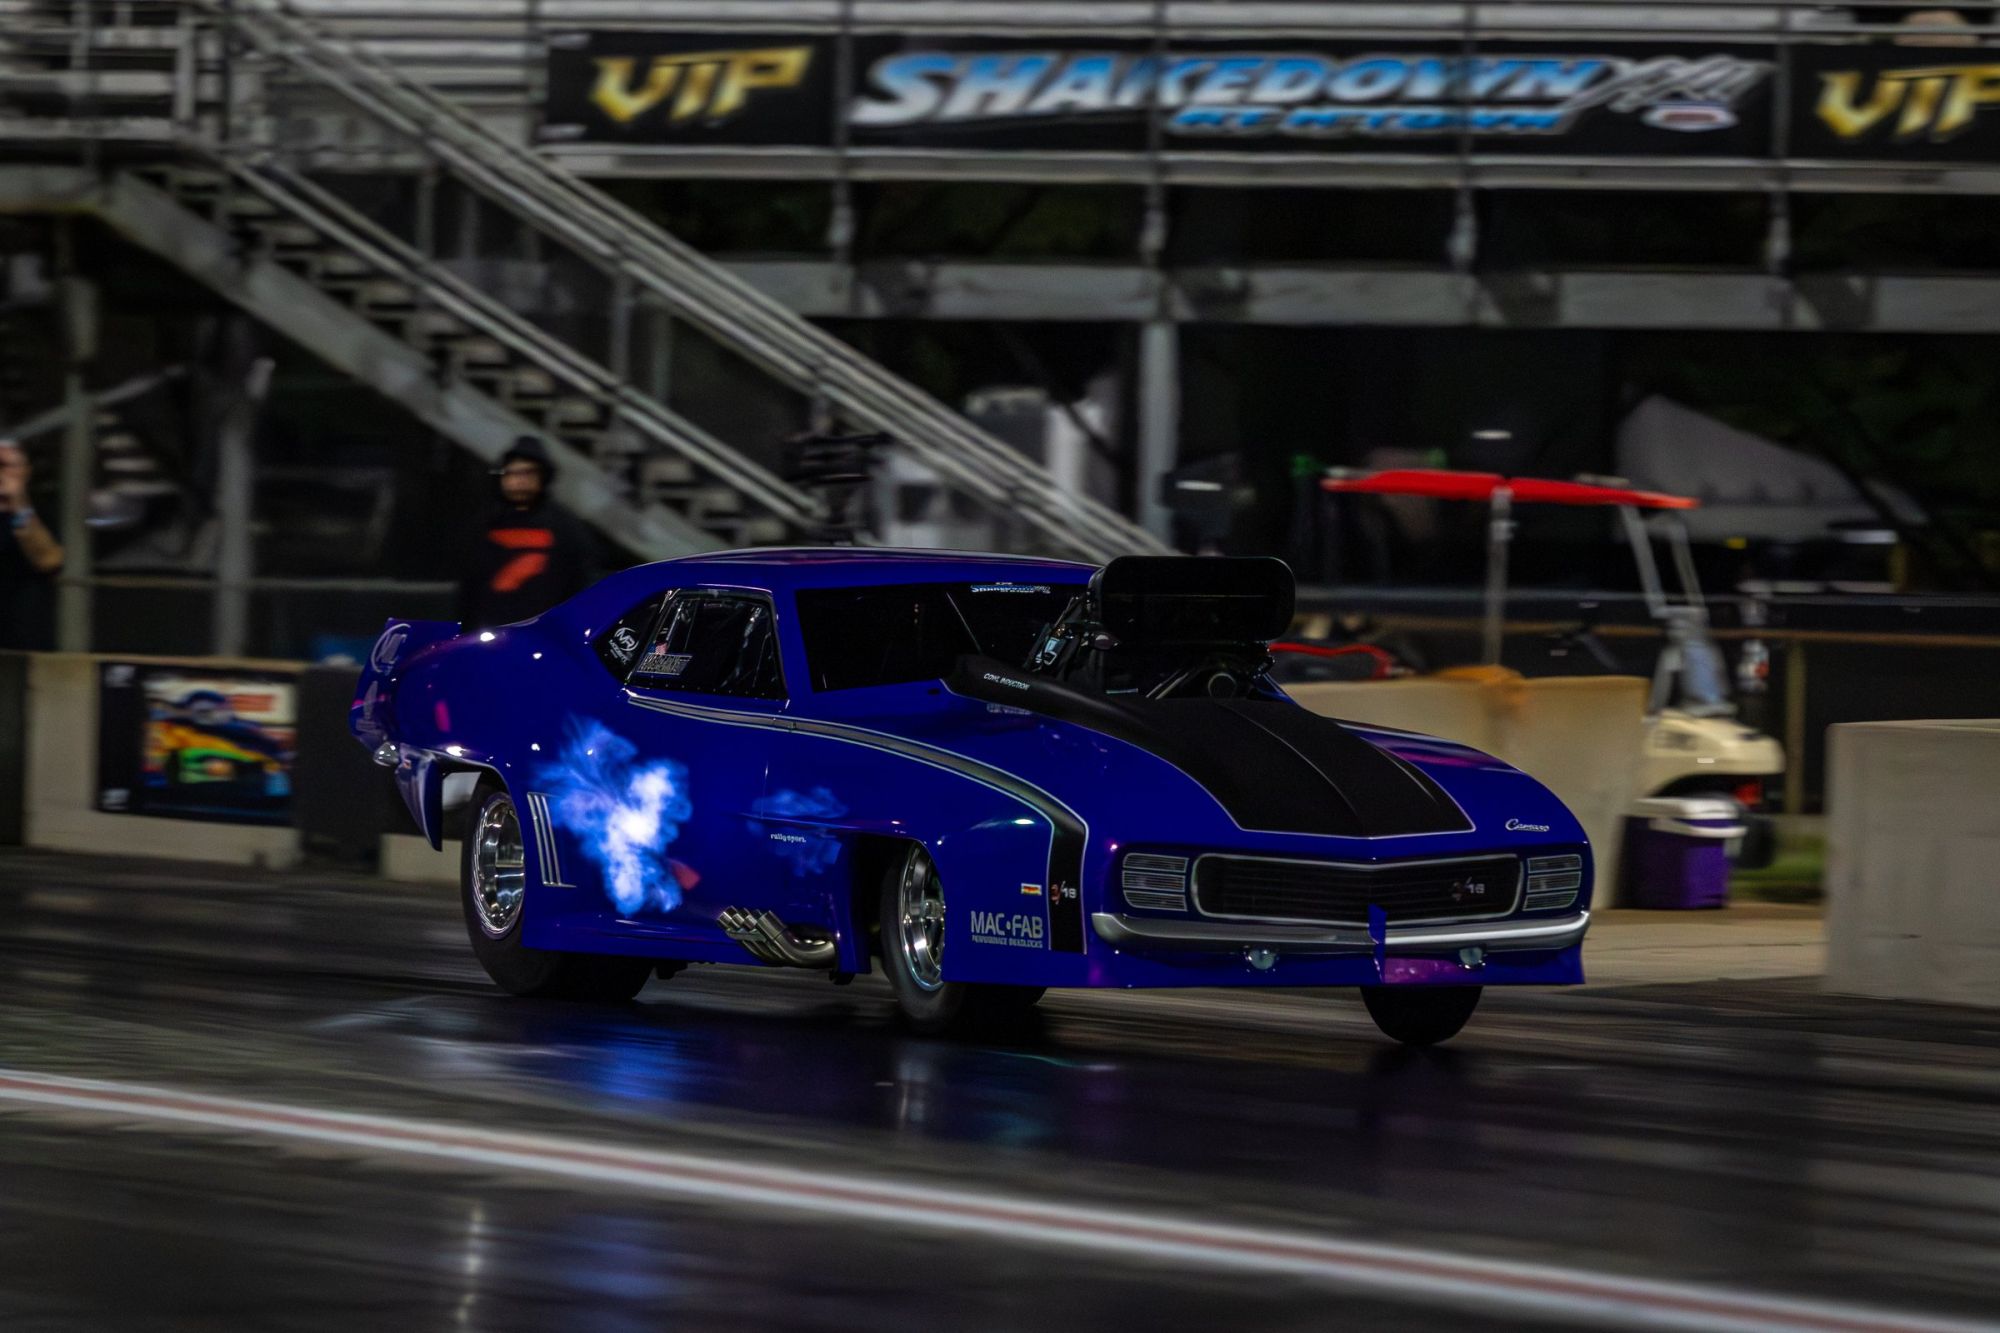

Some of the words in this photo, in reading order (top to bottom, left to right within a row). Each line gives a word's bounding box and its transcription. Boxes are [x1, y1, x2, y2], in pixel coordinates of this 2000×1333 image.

[590, 46, 814, 124] VIP
[852, 50, 1610, 125] SHAKEDOWN
[1505, 818, 1550, 832] Camaro
